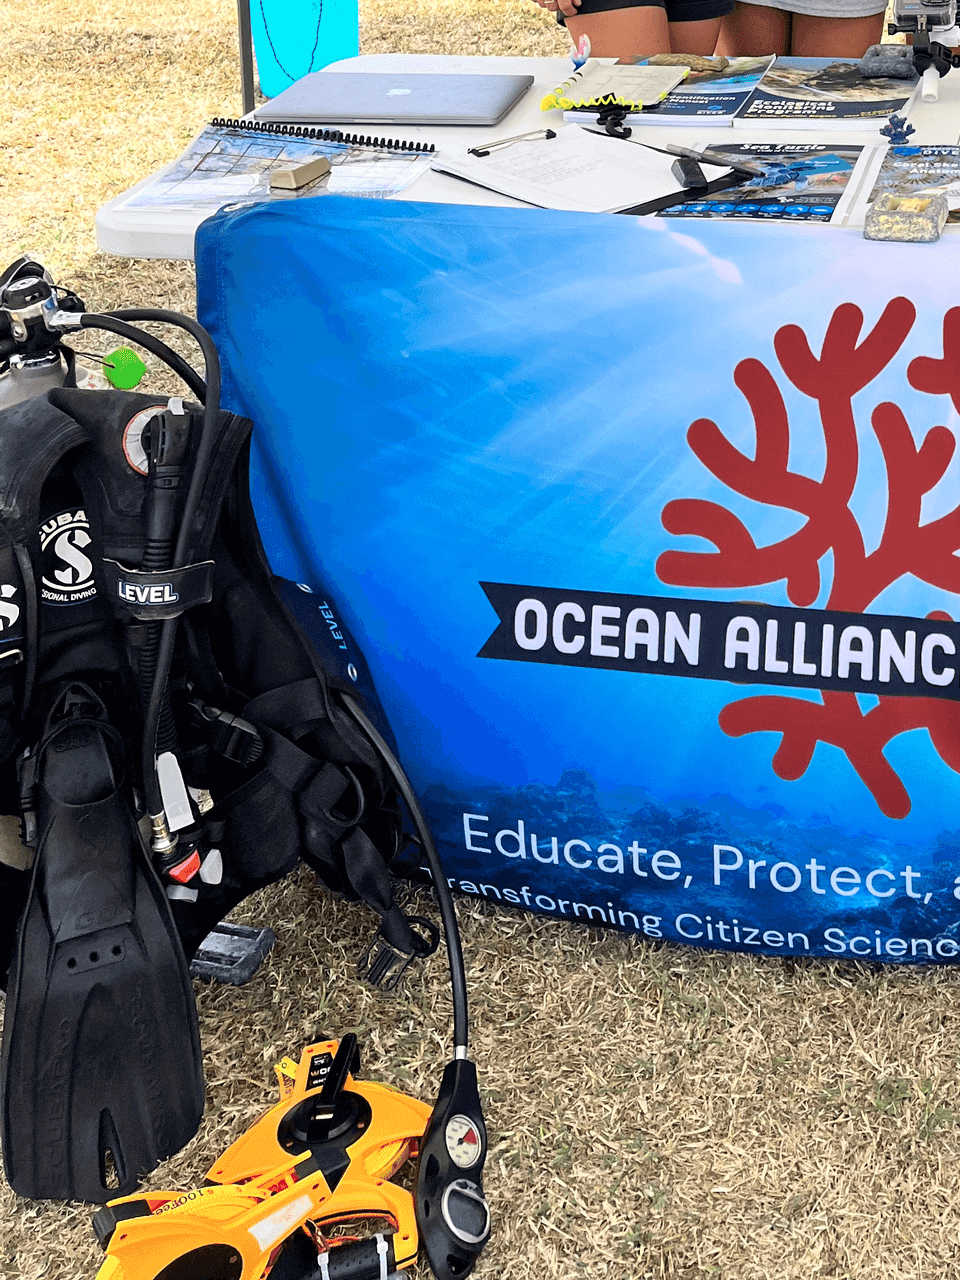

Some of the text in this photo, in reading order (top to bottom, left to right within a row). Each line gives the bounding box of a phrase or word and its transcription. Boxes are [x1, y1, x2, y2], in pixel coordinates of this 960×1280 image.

[751, 104, 836, 112] Monitoring
[753, 99, 833, 108] Ecological
[71, 587, 97, 600] DIVING
[118, 580, 177, 603] LEVEL
[319, 601, 347, 649] LEVEL
[514, 598, 701, 666] OCEAN
[462, 812, 693, 889] Educate,
[713, 844, 933, 905] Protect,
[675, 913, 810, 951] Citizen
[152, 1189, 204, 1217] 100Fee
